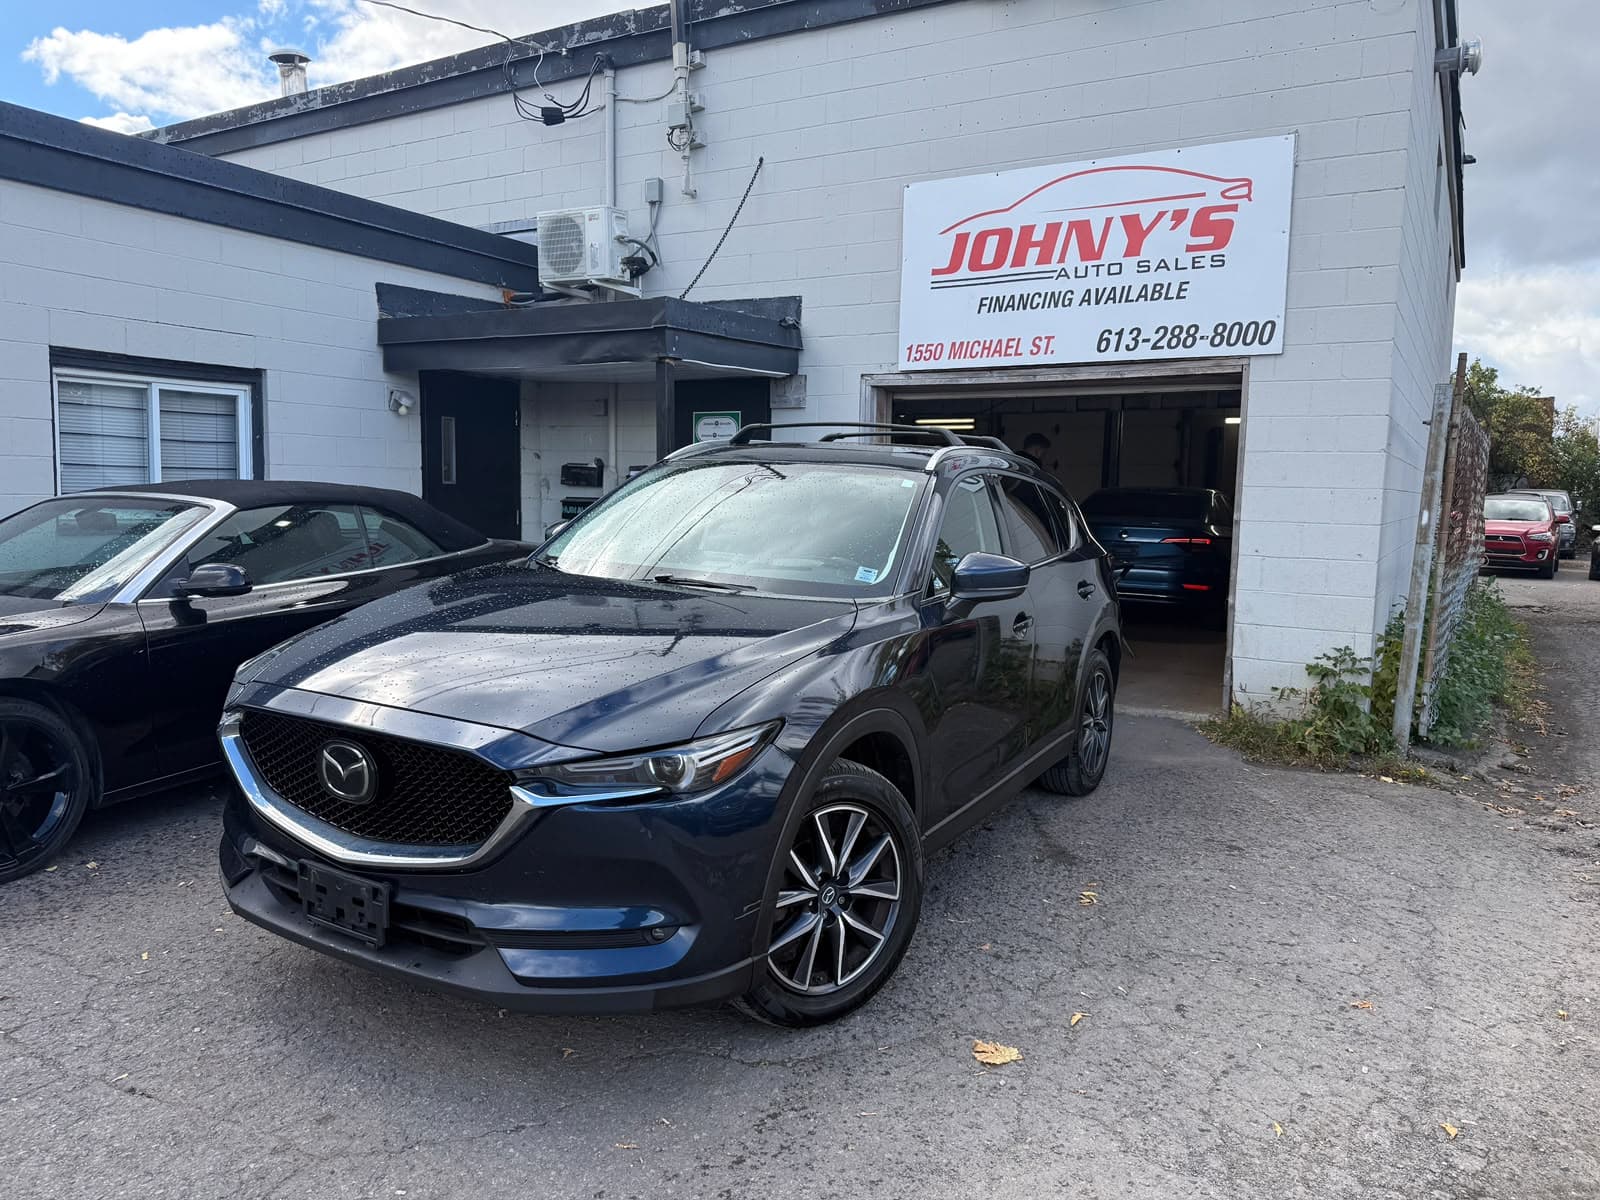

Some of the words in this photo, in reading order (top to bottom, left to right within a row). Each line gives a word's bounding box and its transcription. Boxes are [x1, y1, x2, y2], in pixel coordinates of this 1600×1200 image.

[931, 203, 1239, 276] JOHNY'S
[1055, 262, 1122, 280] AUTO
[1136, 254, 1226, 274] SALES
[977, 290, 1074, 314] FINANCING
[1079, 281, 1190, 307] AVAILABLE
[906, 342, 944, 362] 1550
[947, 337, 1023, 360] MICHAEL
[1029, 335, 1056, 356] ST.
[1096, 320, 1276, 353] 613-288-8000
